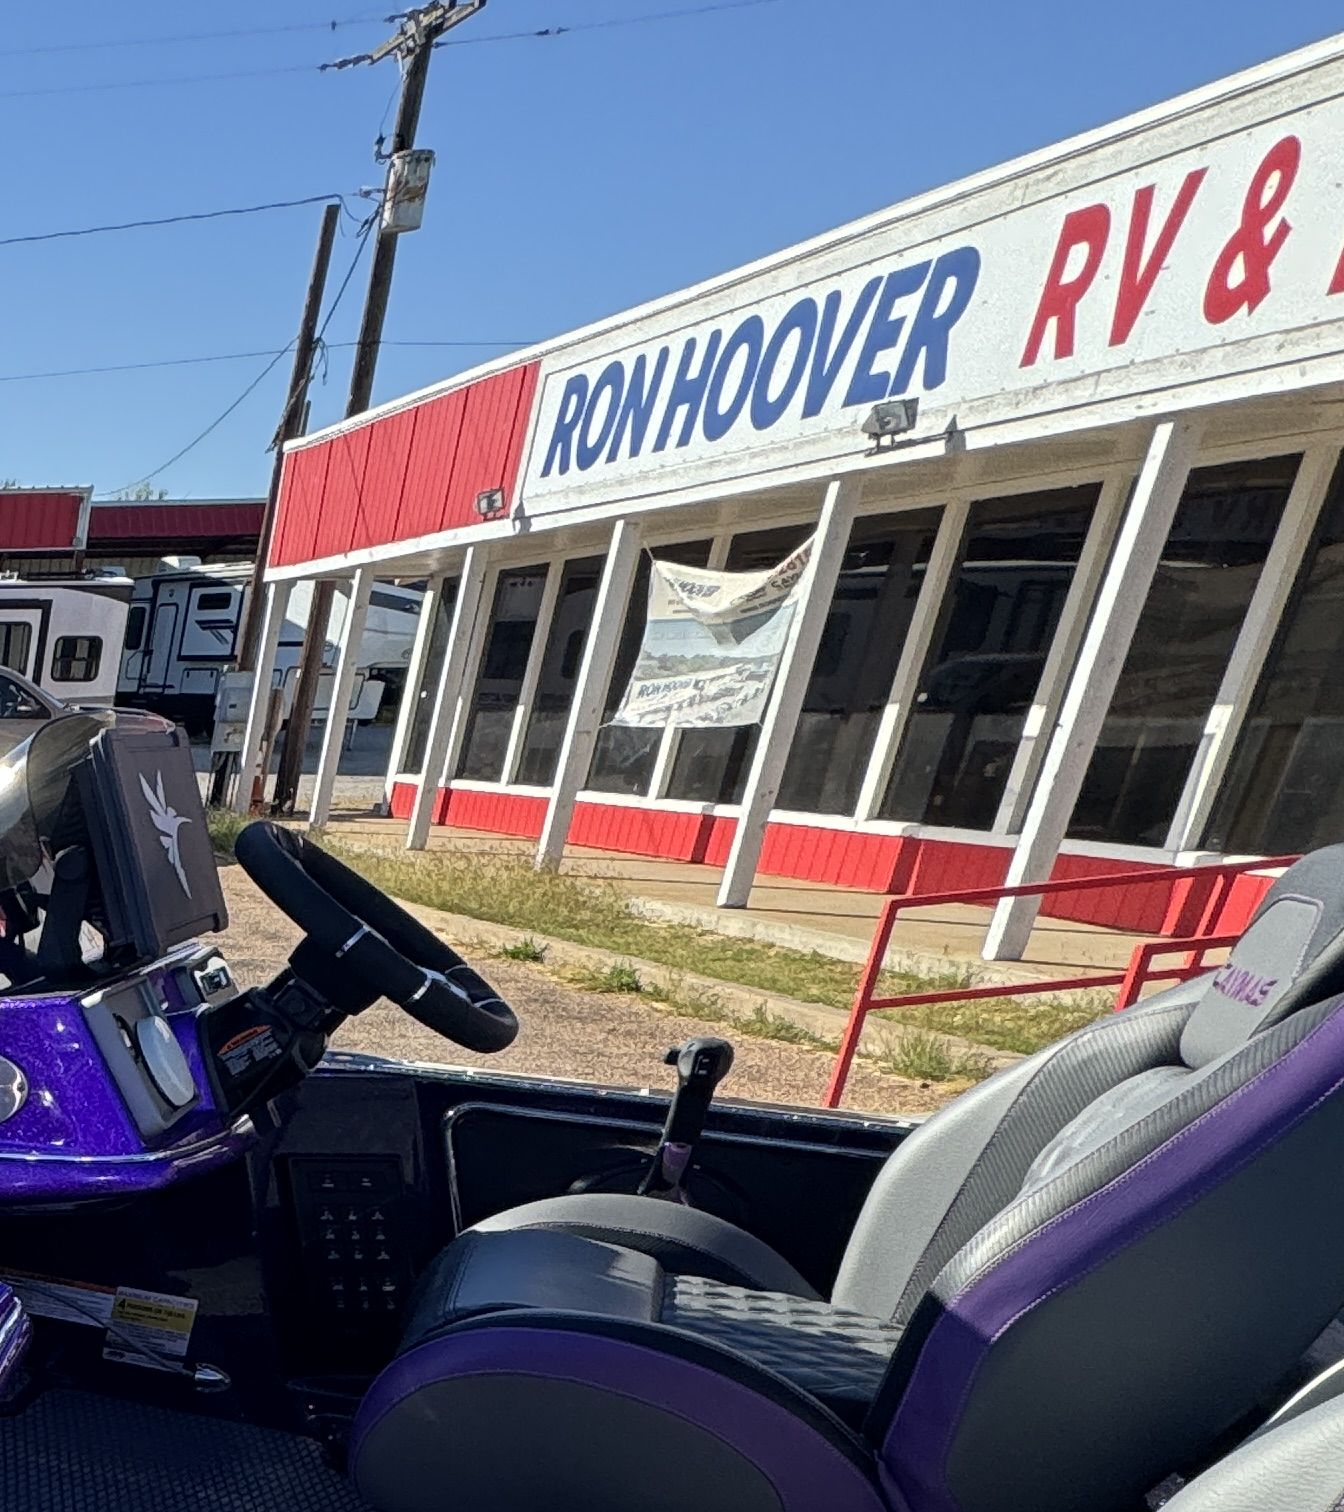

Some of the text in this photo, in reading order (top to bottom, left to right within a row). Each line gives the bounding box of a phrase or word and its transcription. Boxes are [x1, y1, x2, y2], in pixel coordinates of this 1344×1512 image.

[540, 135, 1302, 478] RON HOOVER RV &
